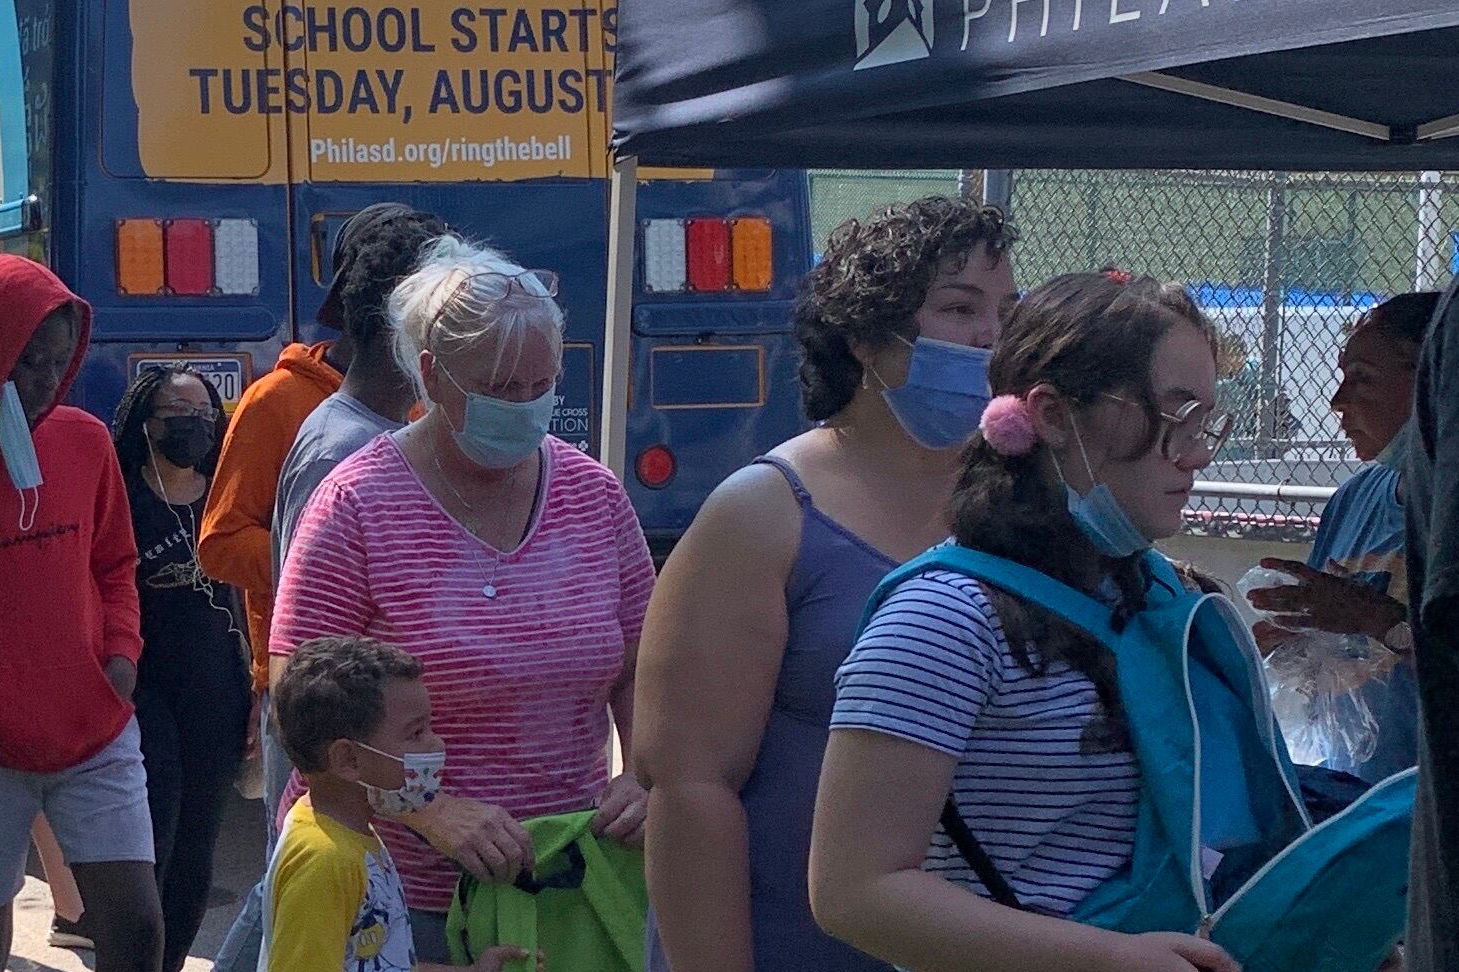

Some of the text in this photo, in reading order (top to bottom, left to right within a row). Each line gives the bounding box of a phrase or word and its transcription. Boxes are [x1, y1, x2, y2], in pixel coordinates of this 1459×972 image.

[243, 5, 436, 53] SCHOOL
[189, 68, 613, 125] TUESDAY, AUGUST
[310, 135, 572, 168] Philasd.org/ringthebell
[562, 408, 589, 417] CROSS
